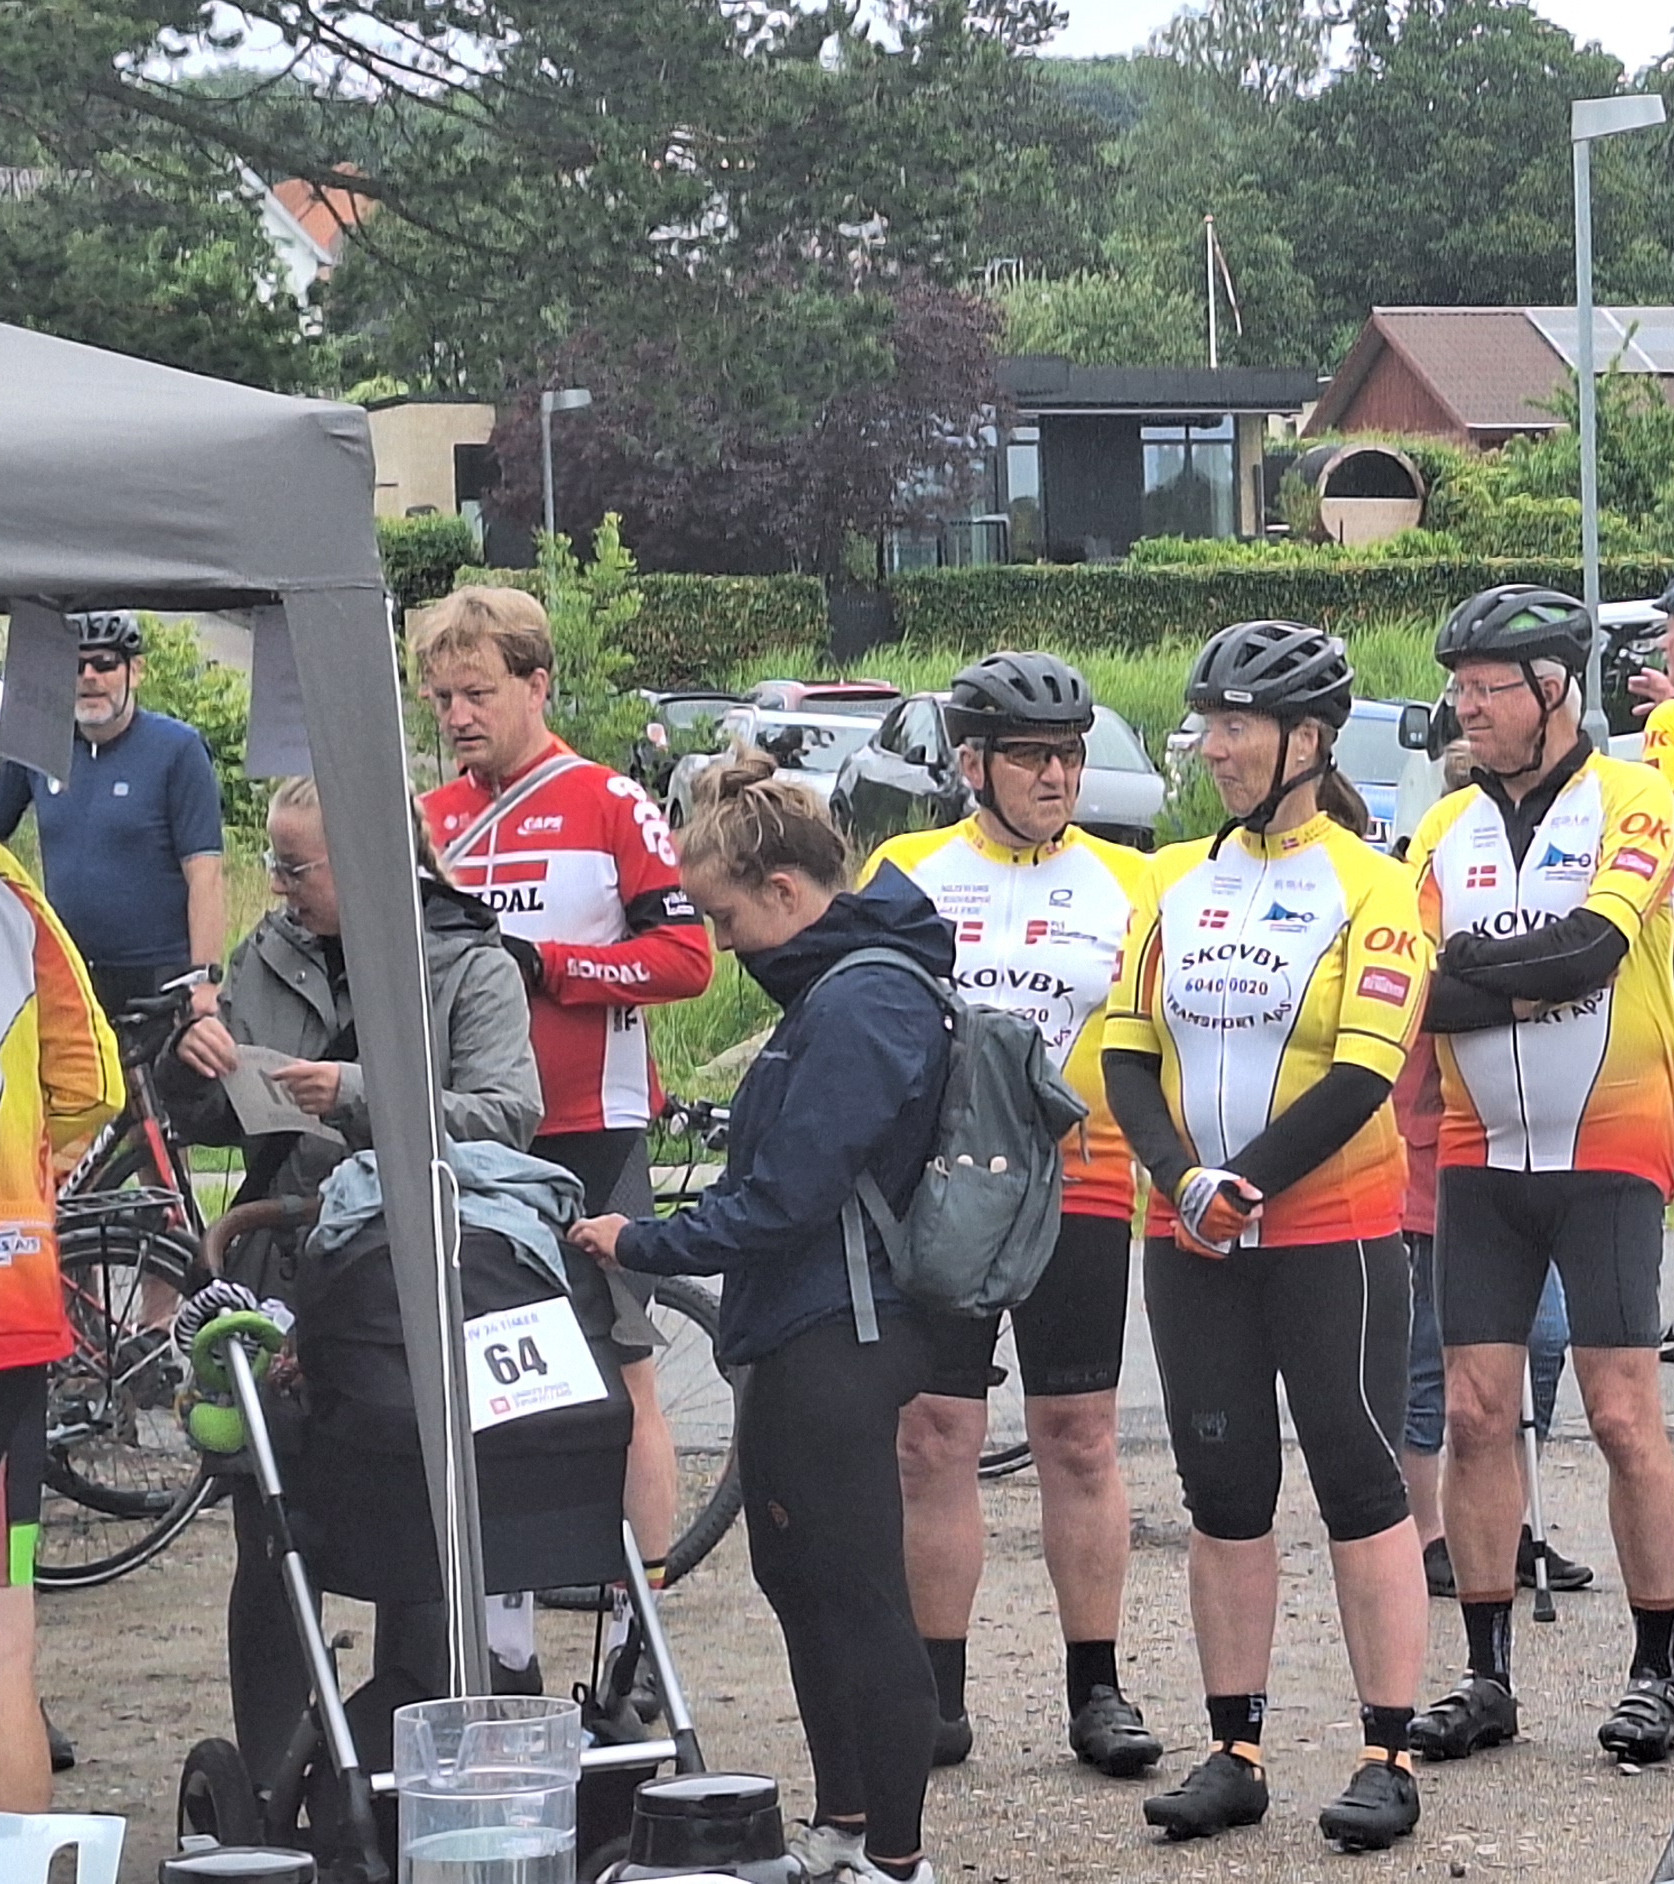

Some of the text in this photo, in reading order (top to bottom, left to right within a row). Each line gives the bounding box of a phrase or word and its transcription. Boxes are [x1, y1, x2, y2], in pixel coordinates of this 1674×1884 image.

[1620, 812, 1671, 848] OK
[1548, 853, 1592, 867] LEO
[477, 887, 544, 913] DAL
[1181, 943, 1290, 974] SKOVBY
[1364, 927, 1418, 962] OK
[957, 968, 1075, 999] KOVBY
[1185, 977, 1268, 995] 6040 0020
[1167, 994, 1255, 1030] TRANSPORT
[484, 1335, 548, 1385] 64
